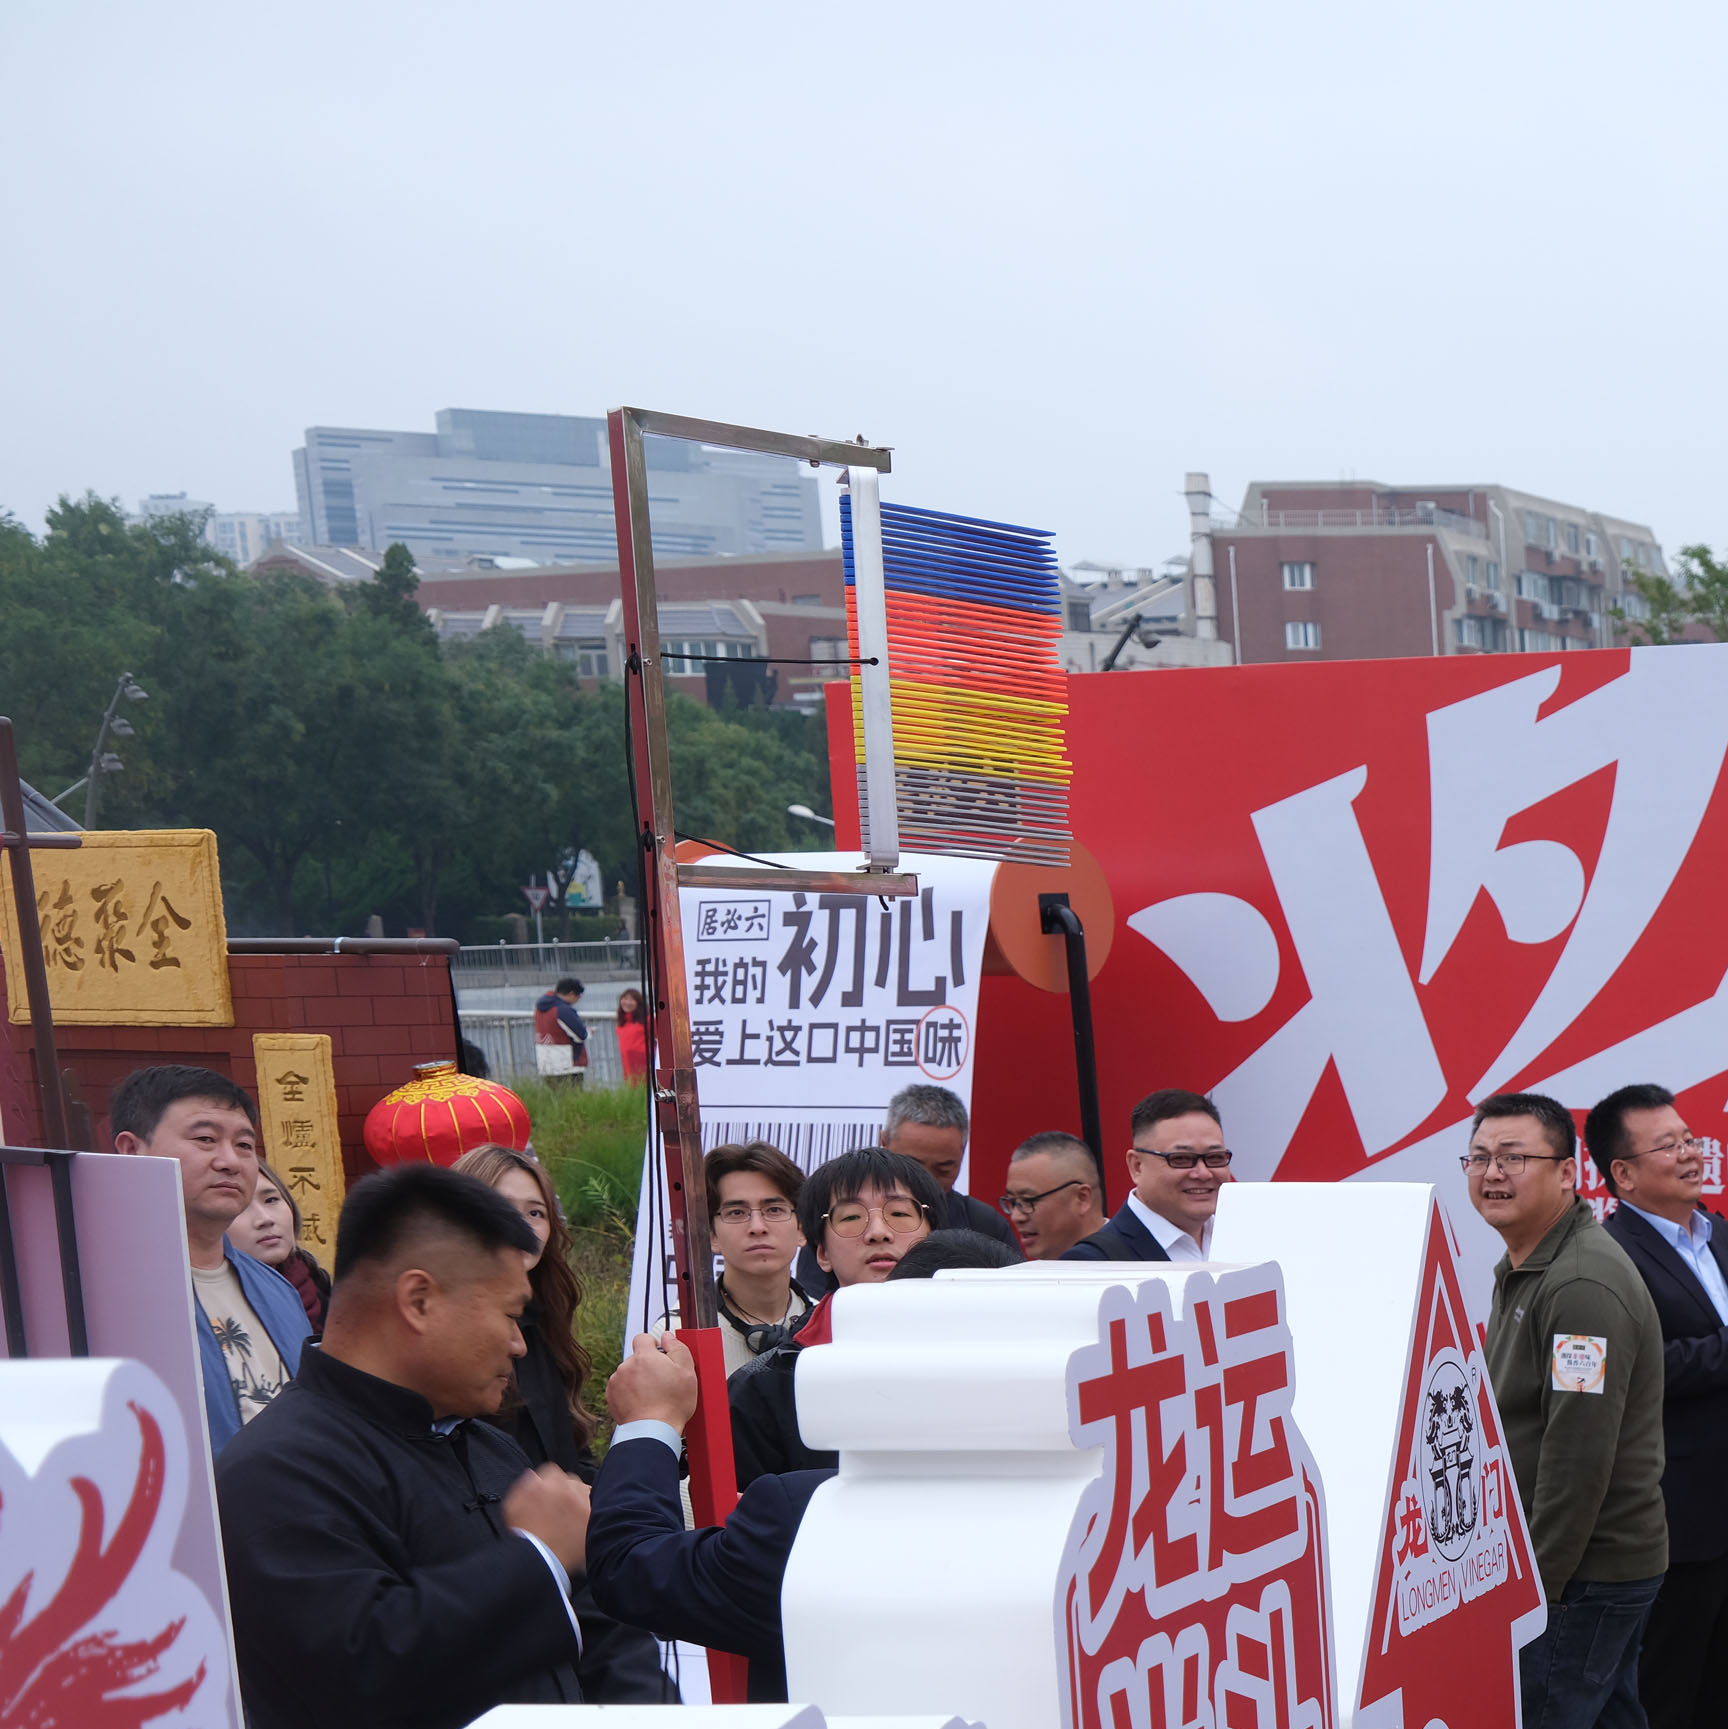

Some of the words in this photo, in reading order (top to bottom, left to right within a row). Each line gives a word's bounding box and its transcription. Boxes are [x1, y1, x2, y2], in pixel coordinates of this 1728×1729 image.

[693, 956, 767, 1006] 我的
[777, 887, 965, 1010] 初心
[691, 1018, 962, 1068] 爱上这口中国味
[1402, 1567, 1456, 1622] LONGMEN
[1460, 1543, 1505, 1589] VINEGAR
